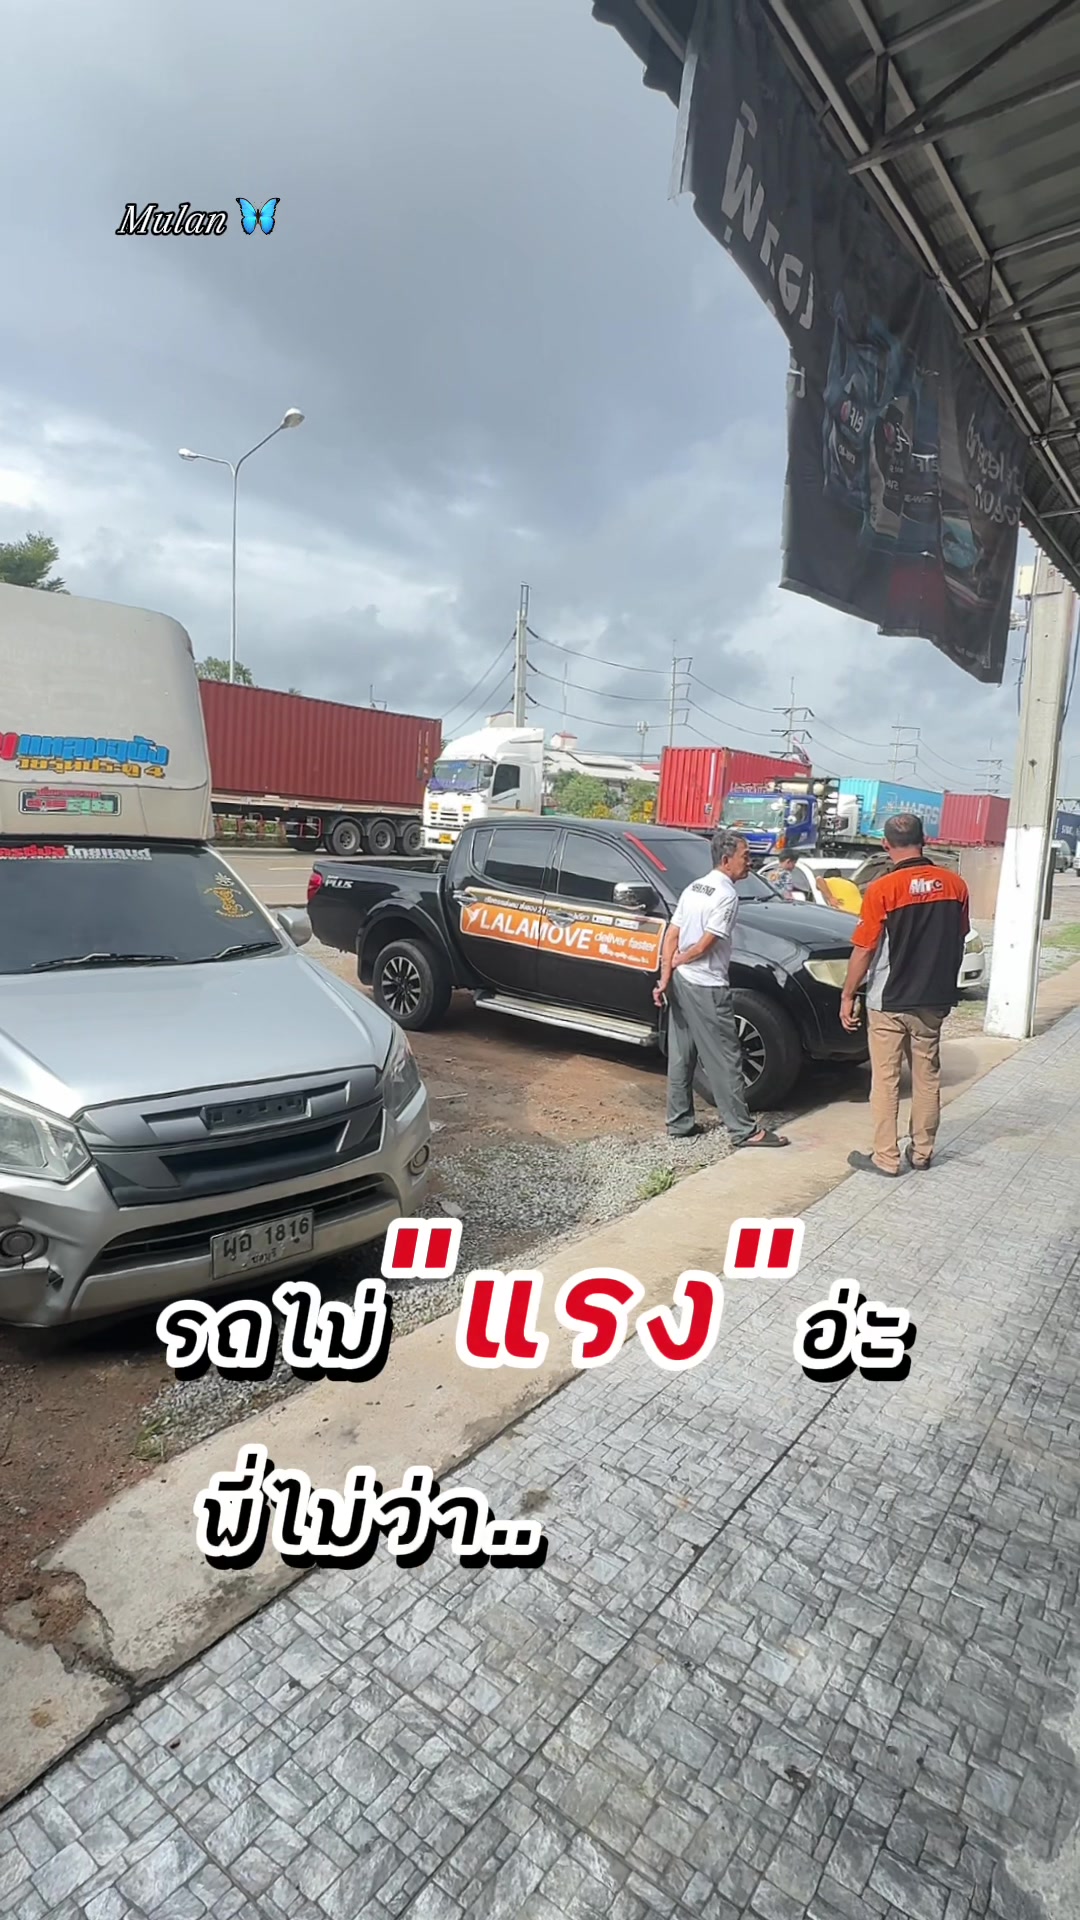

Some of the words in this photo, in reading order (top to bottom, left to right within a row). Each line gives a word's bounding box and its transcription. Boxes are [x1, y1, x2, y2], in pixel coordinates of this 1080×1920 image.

[480, 909, 593, 949] LALAMOVE
[594, 931, 628, 947] deliver
[628, 937, 657, 952] faster
[264, 1216, 309, 1246] 1816
